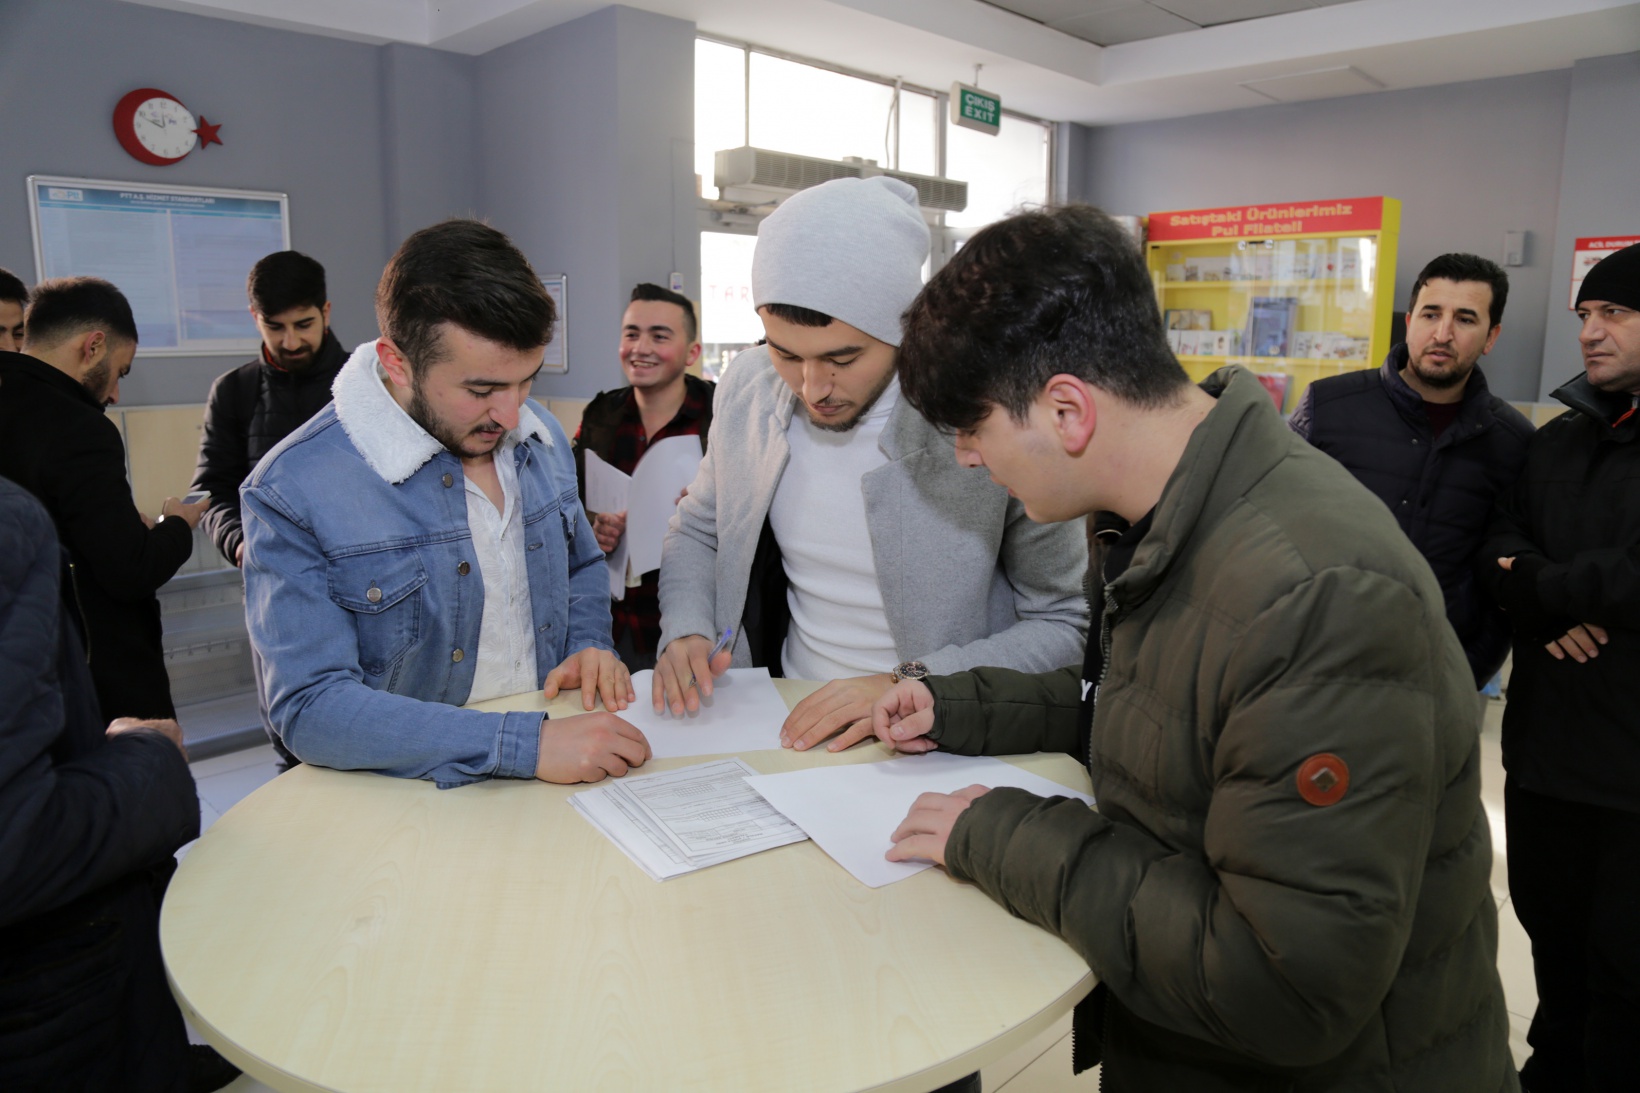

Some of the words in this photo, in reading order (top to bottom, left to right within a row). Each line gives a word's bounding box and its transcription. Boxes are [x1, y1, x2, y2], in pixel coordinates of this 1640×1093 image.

[965, 105, 995, 122] EXIT
[1246, 203, 1353, 221] Ürünlerimiz
[1212, 224, 1240, 237] Pul
[1243, 221, 1303, 236] Filateli
